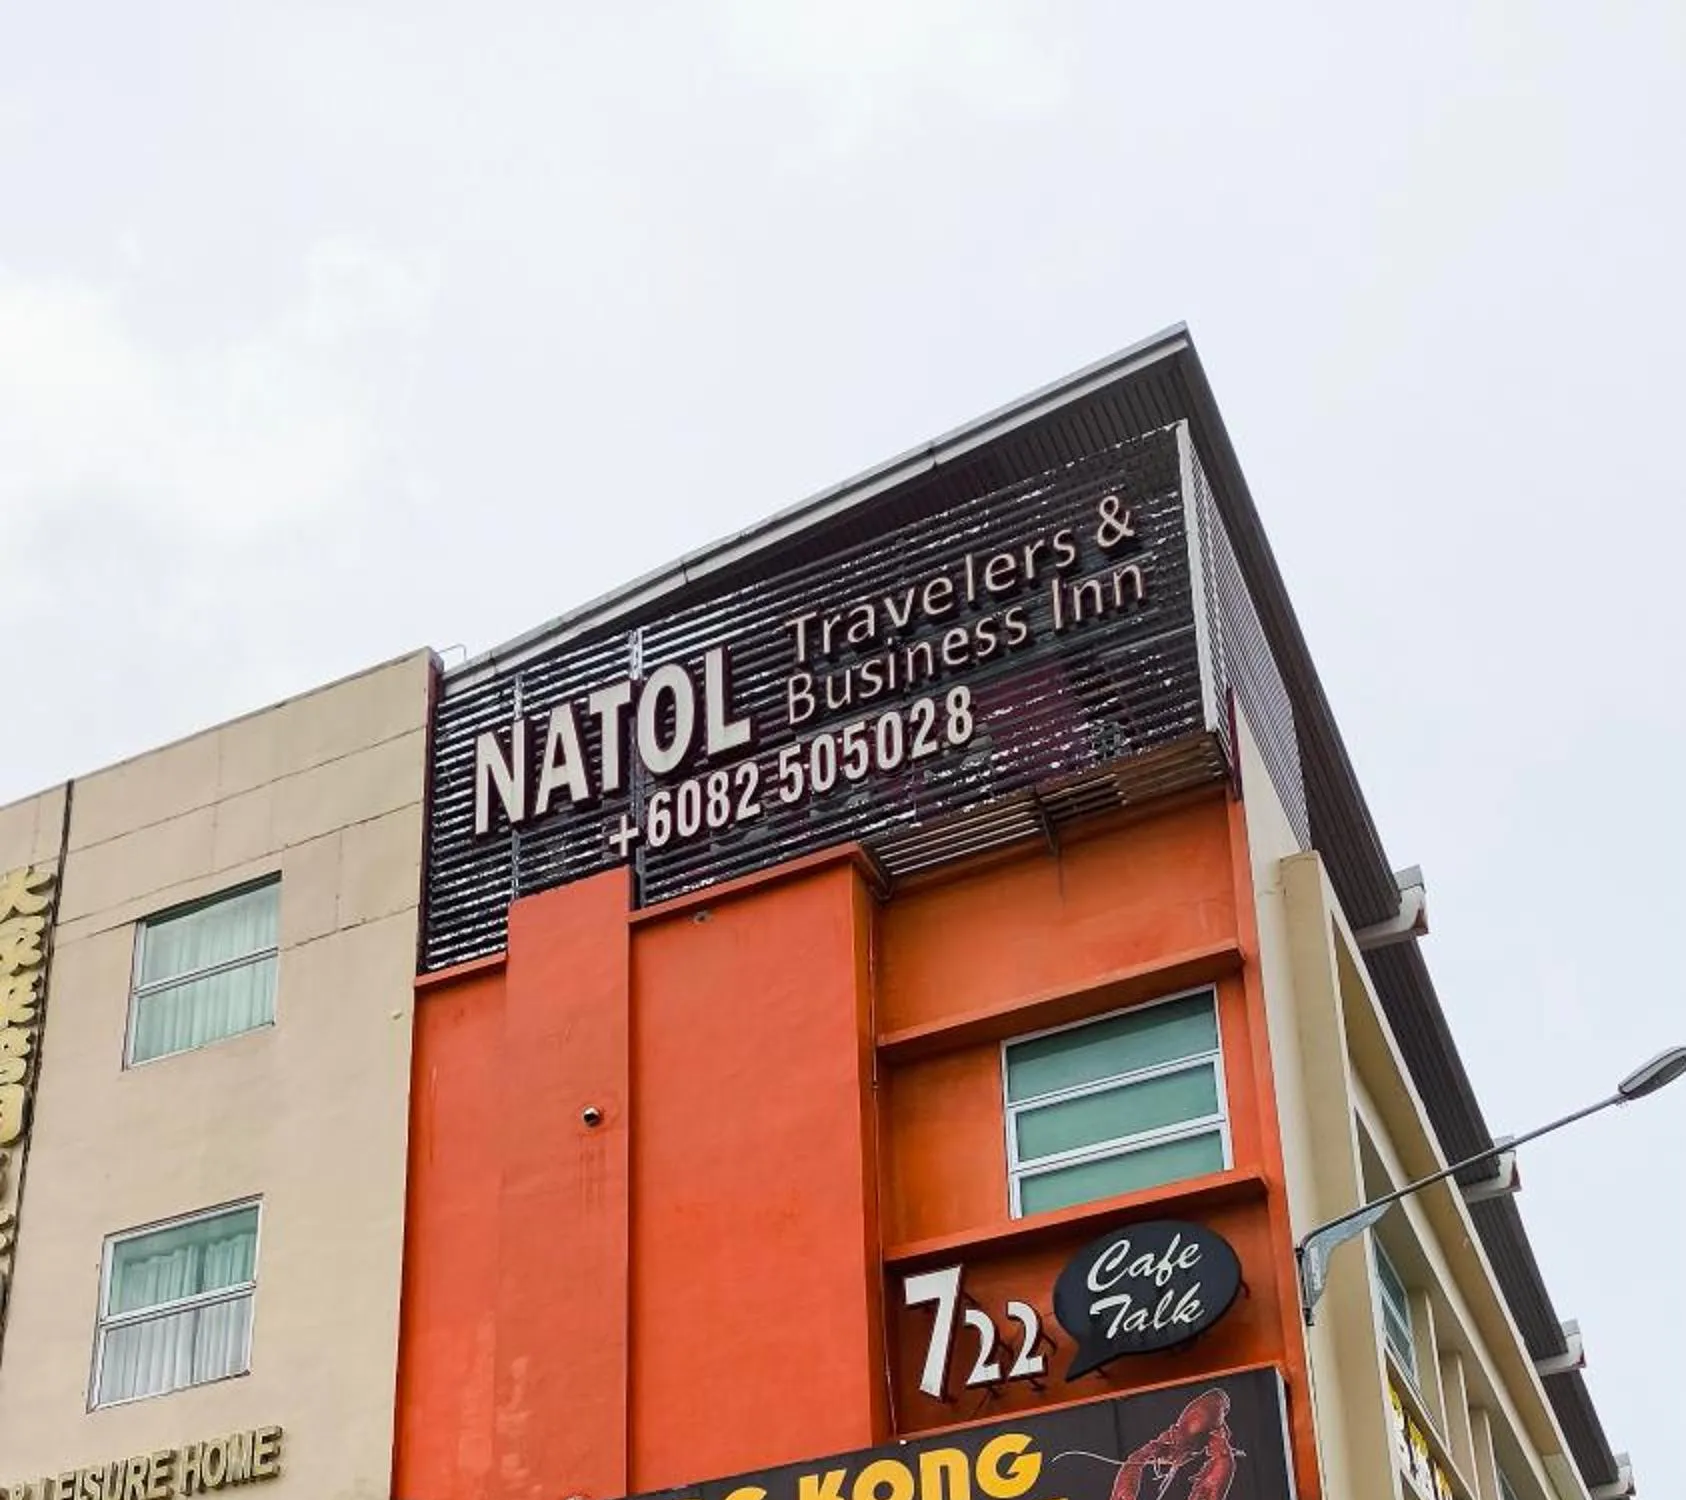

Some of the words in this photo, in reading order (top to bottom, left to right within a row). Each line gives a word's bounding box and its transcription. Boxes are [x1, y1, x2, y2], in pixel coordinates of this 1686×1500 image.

[784, 526, 1077, 665] Travelers
[1096, 494, 1137, 551] &
[786, 604, 1028, 725] Business
[1051, 558, 1146, 632] Inn
[473, 644, 752, 836] NATOL
[608, 761, 762, 858] +6082
[778, 684, 975, 804] 505028
[903, 1262, 1045, 1400] 722
[1086, 1233, 1202, 1293] Cafe
[1089, 1281, 1206, 1341] Talk
[179, 1425, 283, 1496] HOME
